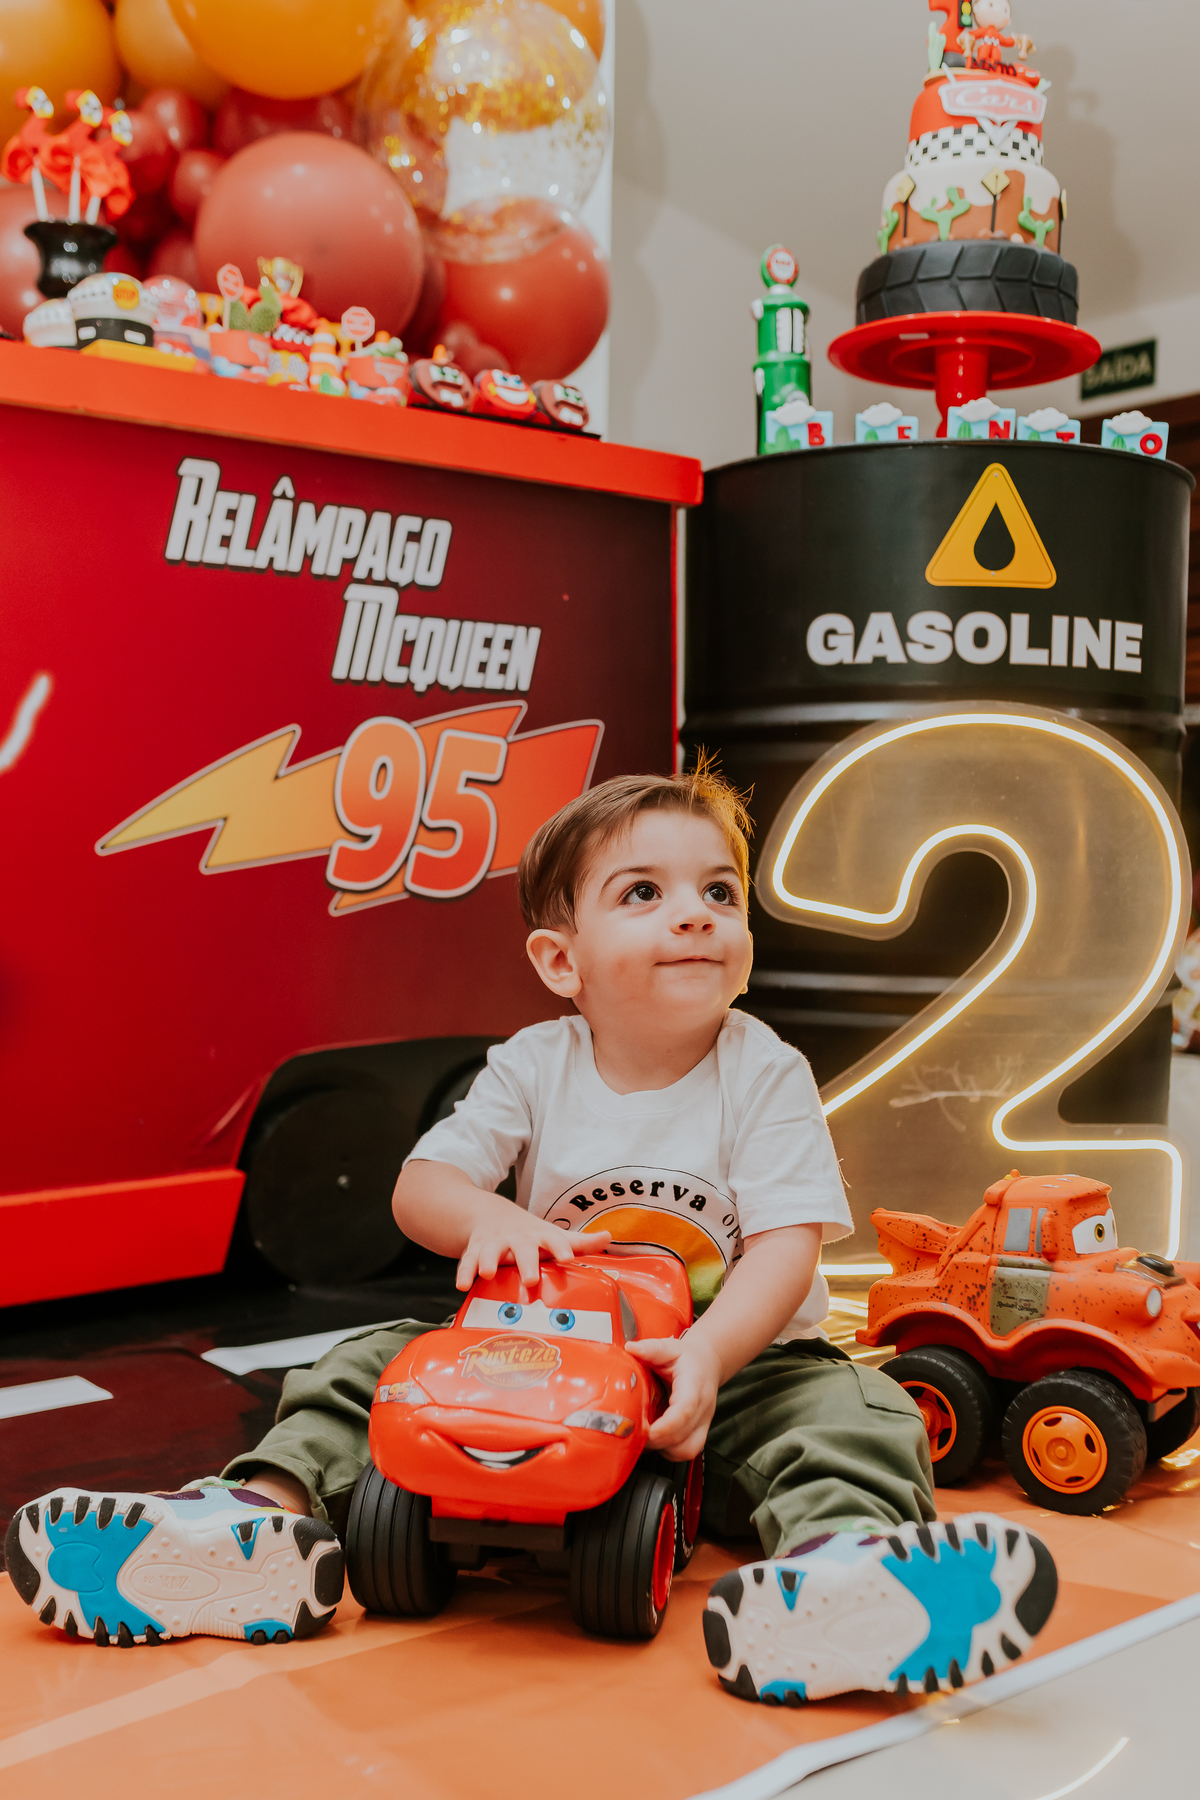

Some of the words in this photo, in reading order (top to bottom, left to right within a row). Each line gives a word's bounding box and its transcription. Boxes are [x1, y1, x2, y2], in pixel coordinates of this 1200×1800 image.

[956, 86, 1034, 113] Cars
[807, 422, 826, 446] B
[806, 610, 1143, 674] GASOLINE
[326, 715, 508, 898] 95
[766, 706, 1188, 1276] 2
[569, 1180, 707, 1212] Reserva
[387, 1381, 411, 1402] 95
